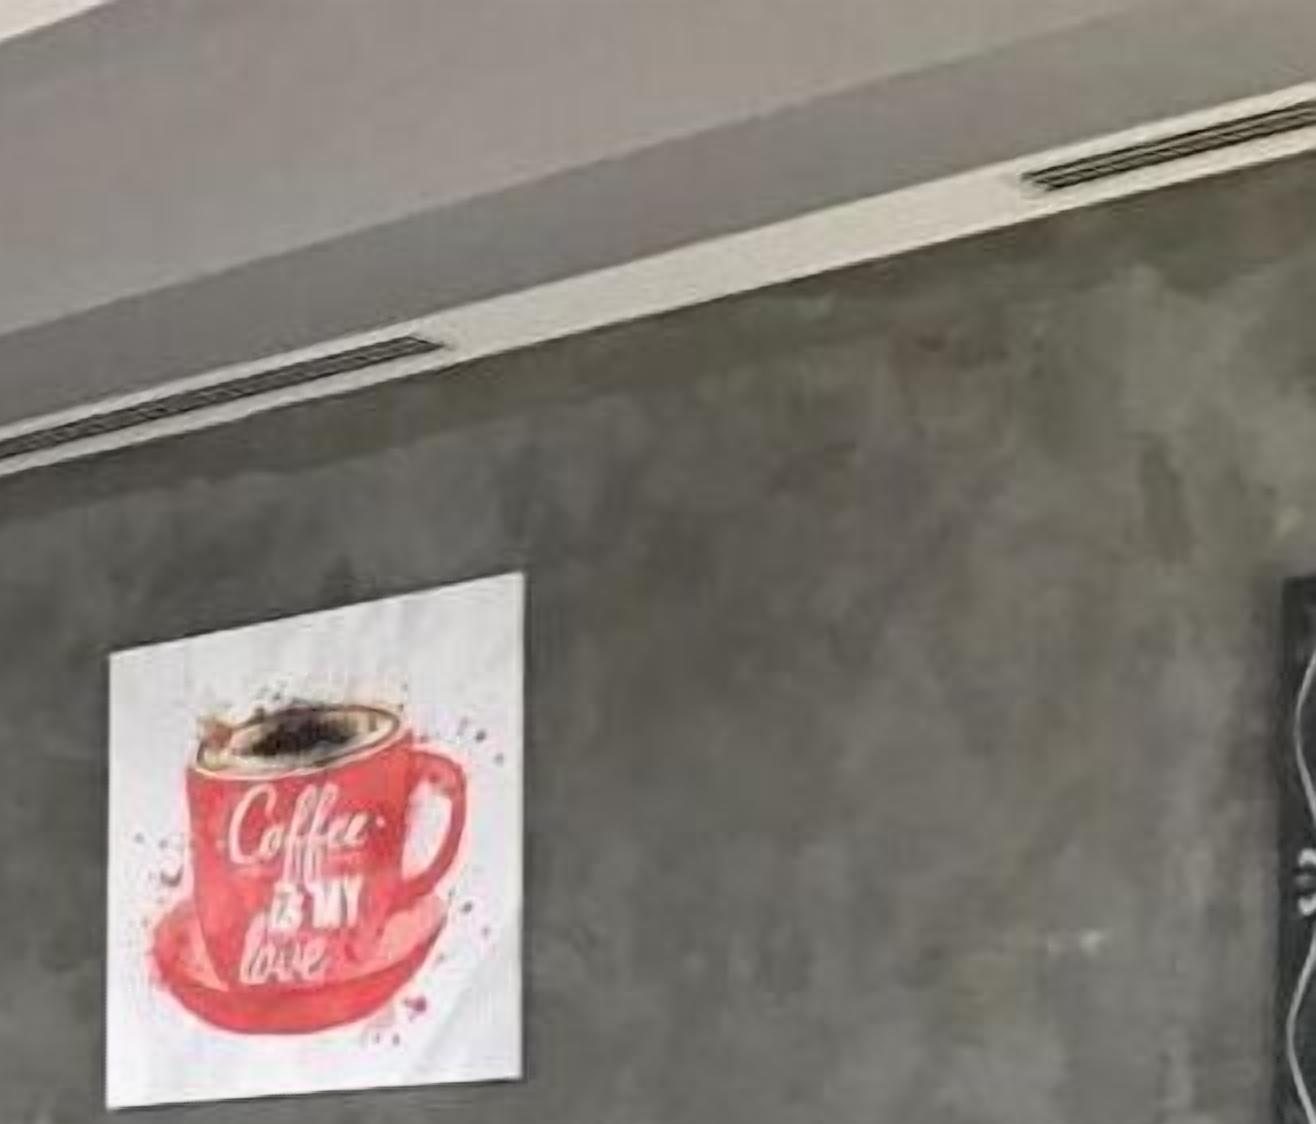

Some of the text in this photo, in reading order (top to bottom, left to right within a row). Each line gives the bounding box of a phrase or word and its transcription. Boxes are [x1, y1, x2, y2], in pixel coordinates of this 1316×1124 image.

[229, 782, 370, 886] Coffee
[310, 873, 364, 929] MY
[239, 911, 330, 985] love
